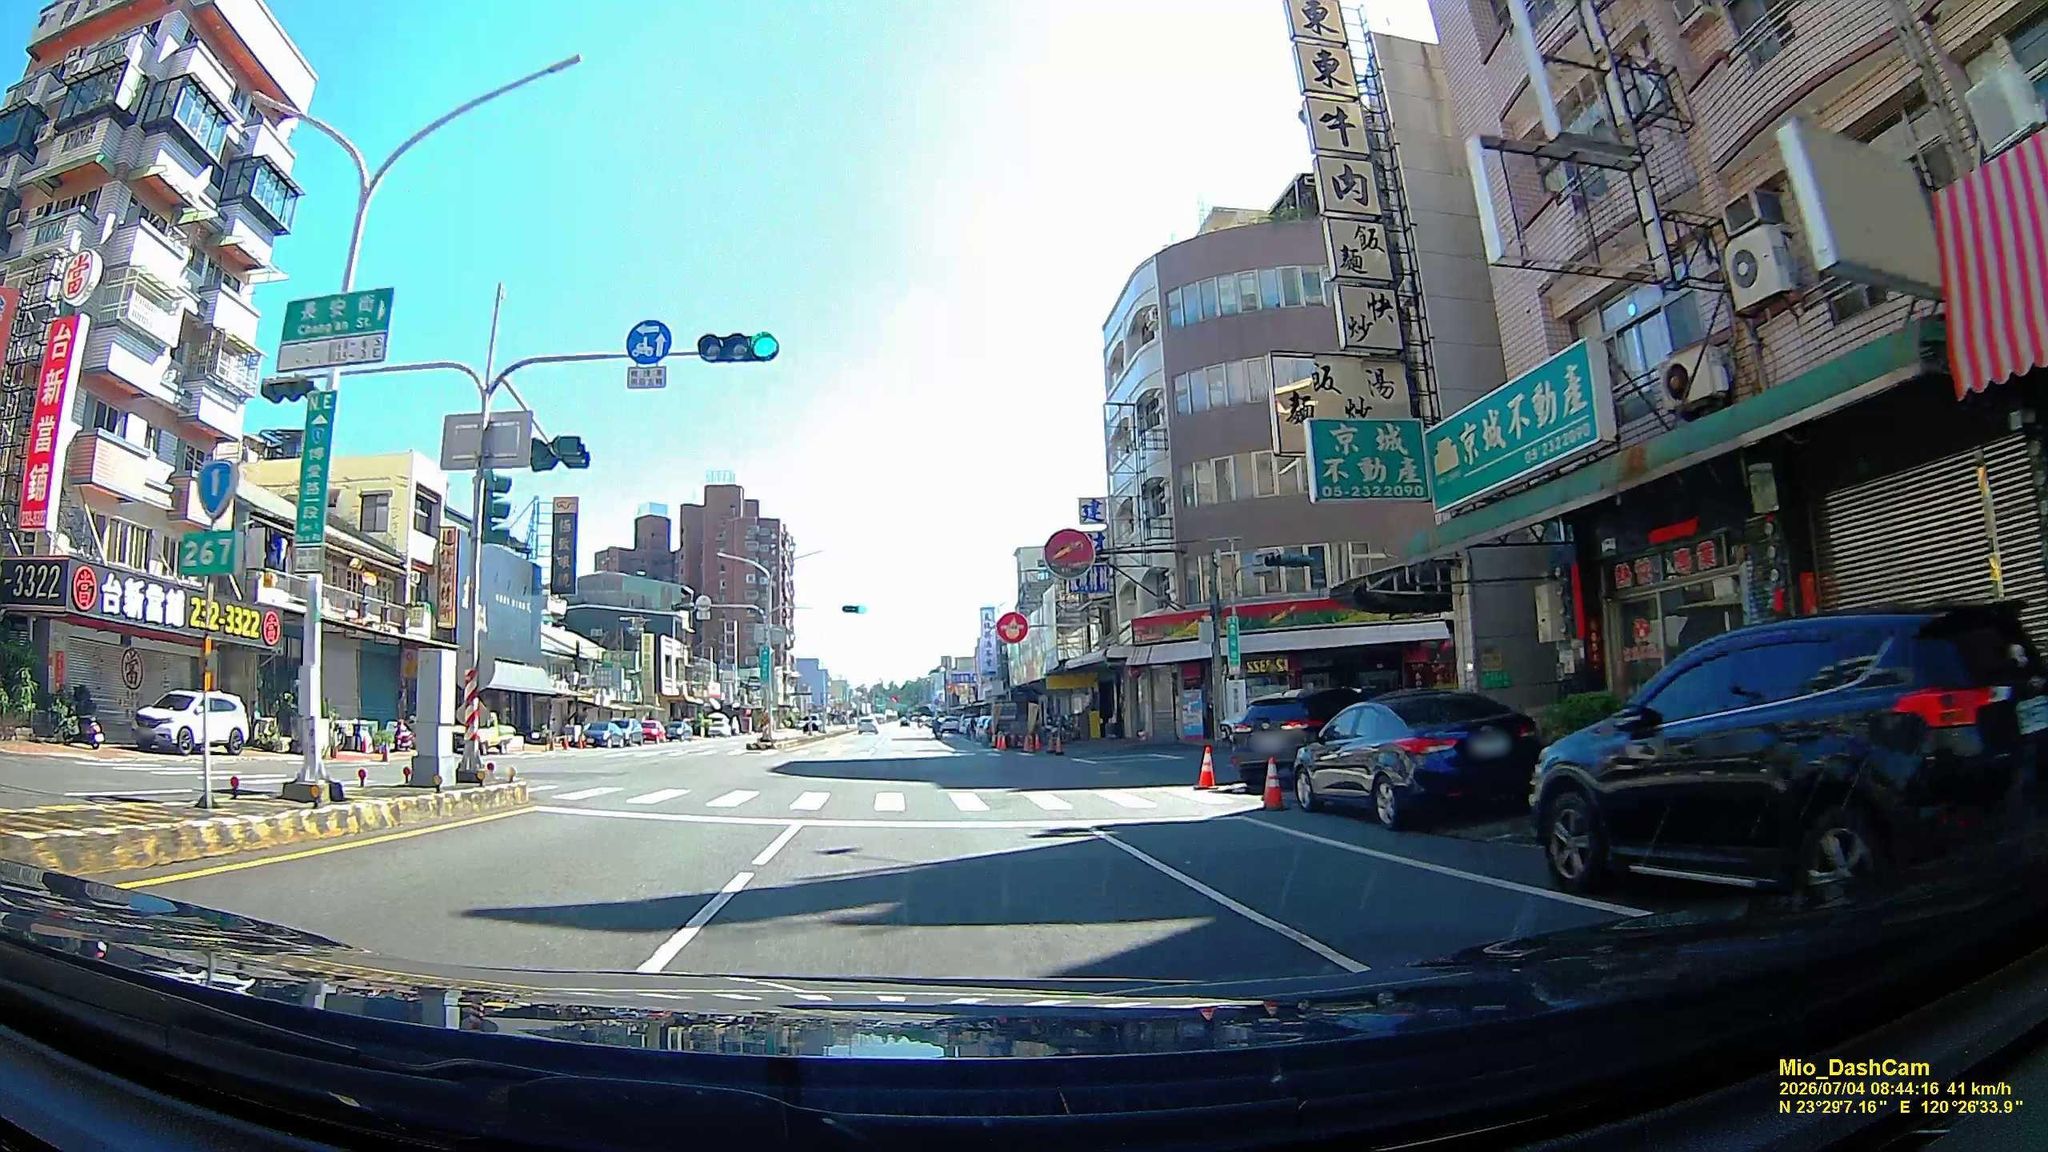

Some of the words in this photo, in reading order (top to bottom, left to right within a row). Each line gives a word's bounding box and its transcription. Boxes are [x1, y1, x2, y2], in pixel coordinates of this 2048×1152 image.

[1302, 0, 1369, 207] 東東牛肉
[1460, 364, 1588, 466] 京城不動產
[1329, 423, 1408, 456] 京城
[1323, 457, 1422, 484] 不動產
[1322, 485, 1424, 498] 05-2322090
[184, 539, 231, 567] 267
